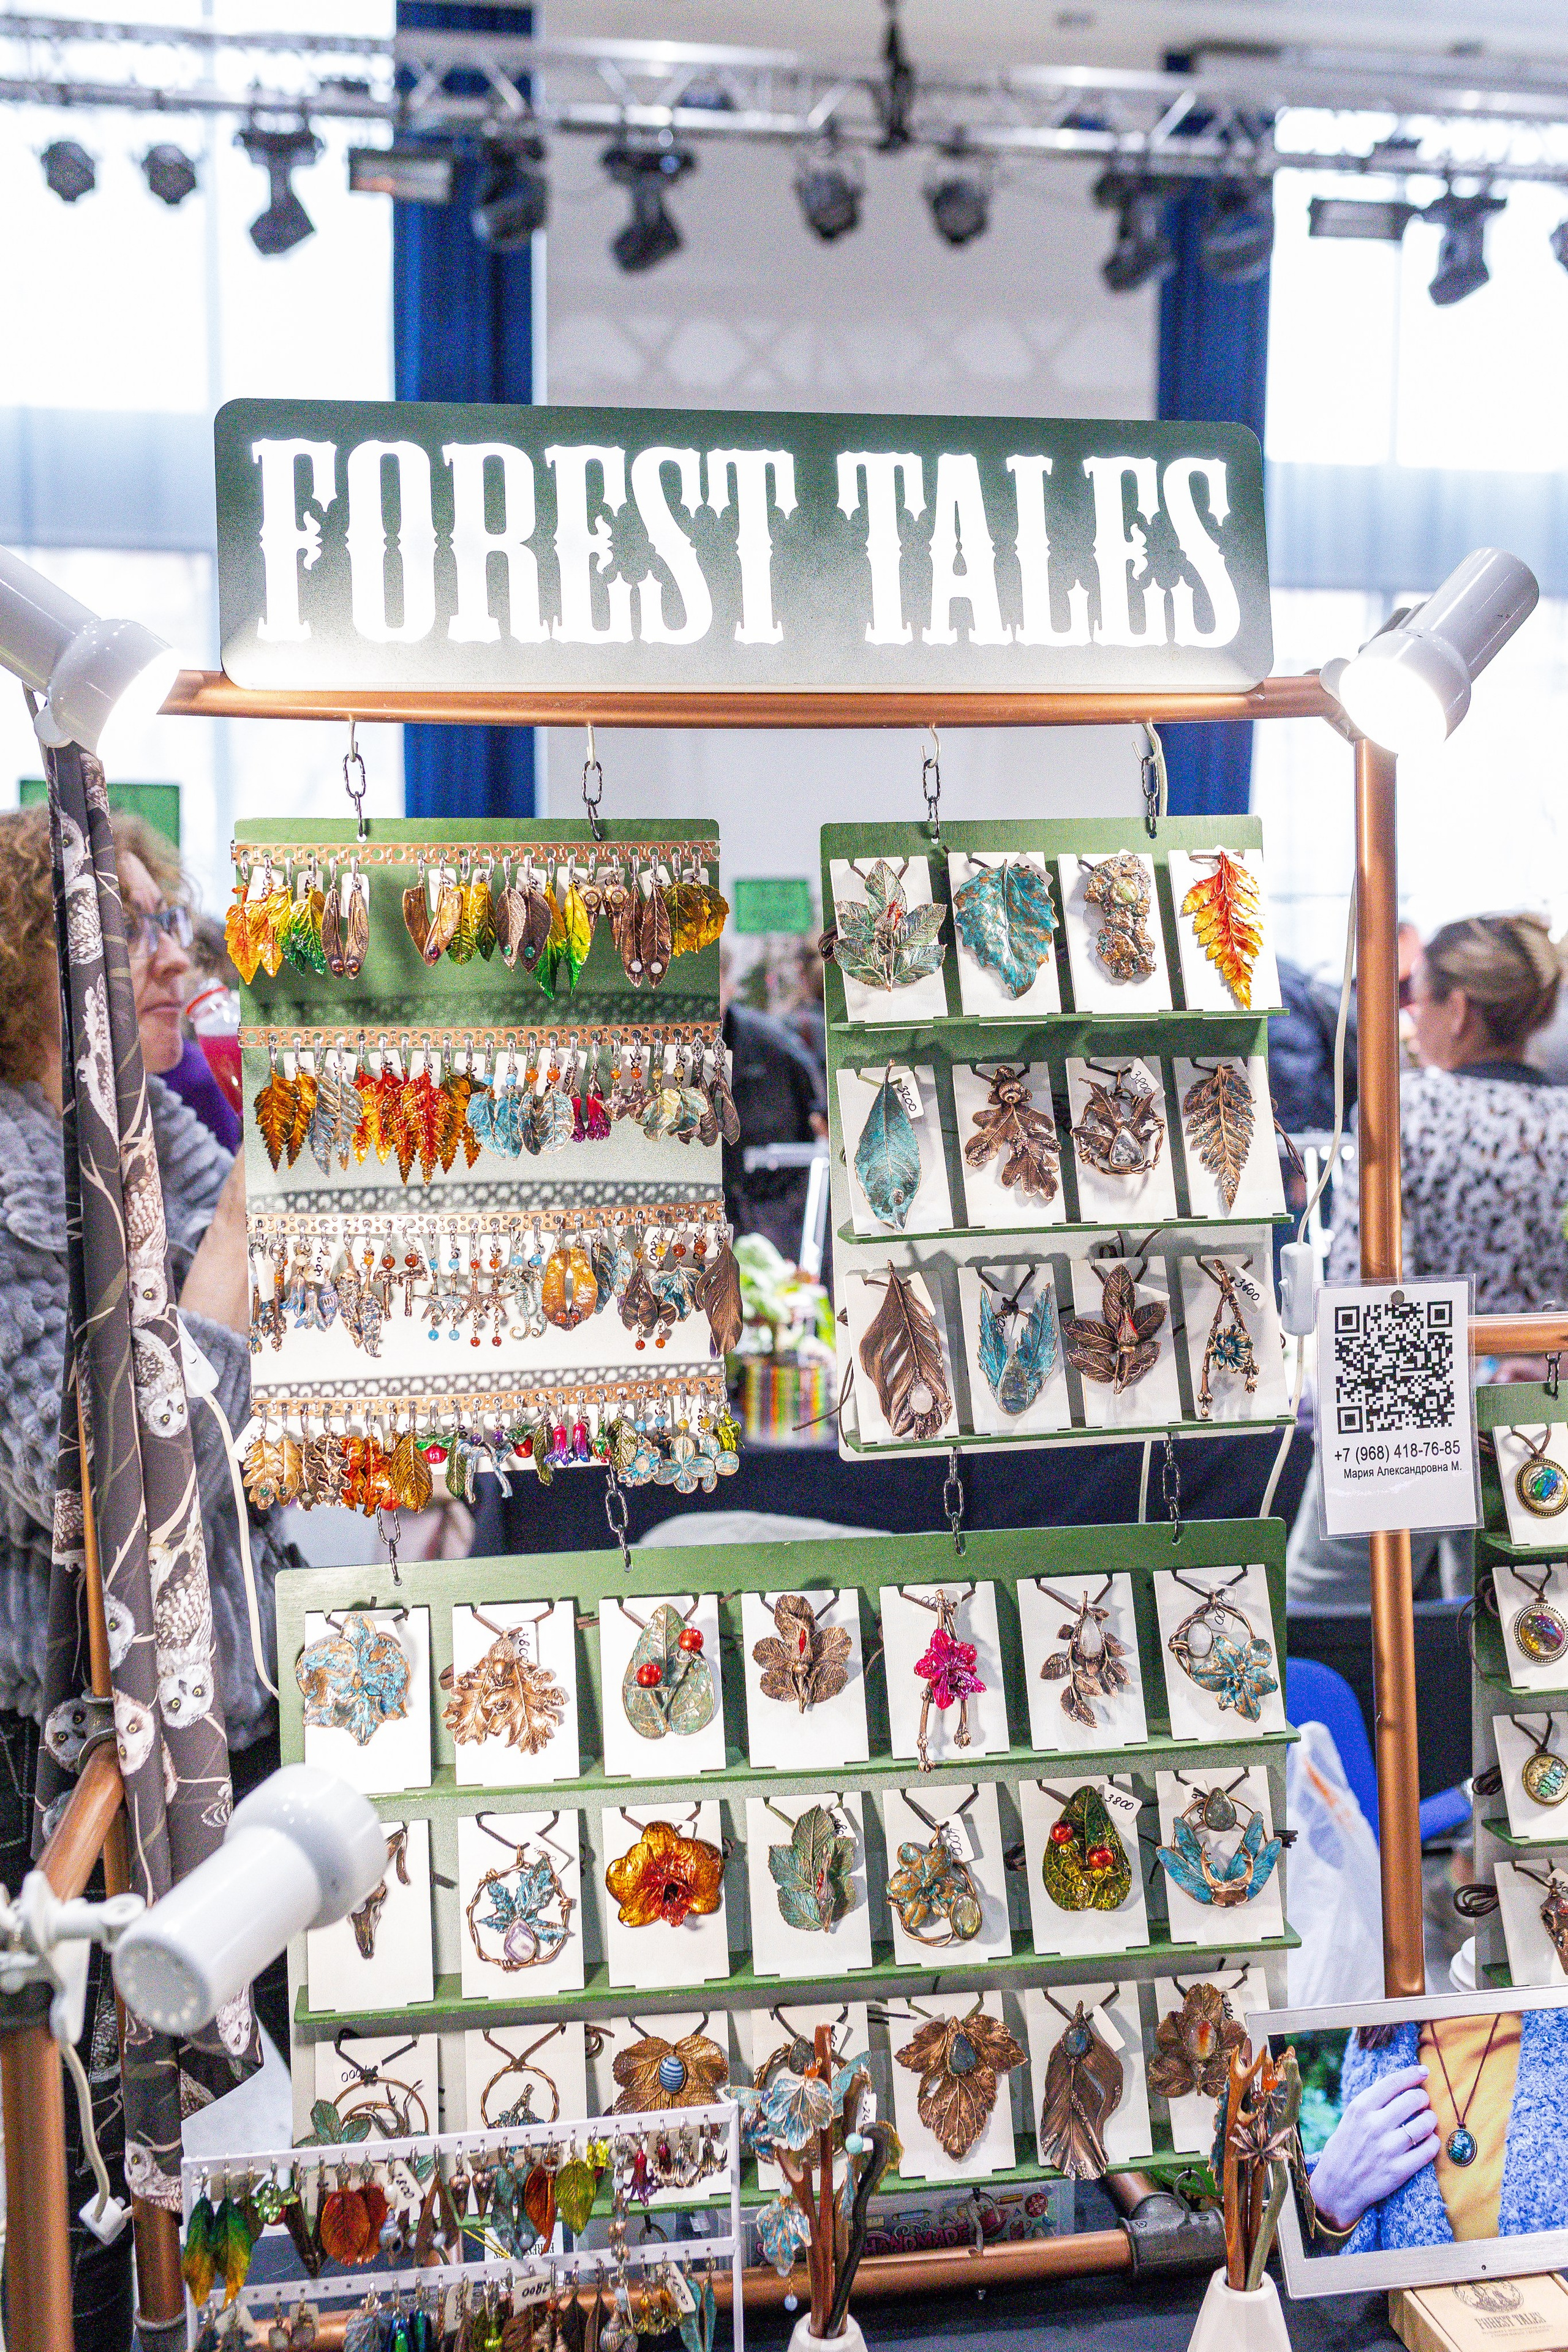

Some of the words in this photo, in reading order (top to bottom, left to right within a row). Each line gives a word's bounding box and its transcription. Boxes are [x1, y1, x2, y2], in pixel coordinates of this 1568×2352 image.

[252, 437, 797, 646] FOREST
[837, 451, 1241, 647] TALES
[1129, 1070, 1153, 1095] 3800
[897, 1085, 917, 1112] 3200
[1234, 1278, 1260, 1302] 3600
[1335, 1447, 1350, 1463] +7
[1355, 1444, 1390, 1465] (968)
[1393, 1440, 1460, 1458] 418-76-85
[1344, 1468, 1374, 1480] Мария
[1377, 1463, 1448, 1477] Александровна
[1451, 1460, 1462, 1471] М.
[1104, 1793, 1134, 1811] 3800
[946, 1827, 963, 1856] 4000
[1474, 2315, 1515, 2329] FOREST
[1511, 2312, 1547, 2326] TALES
